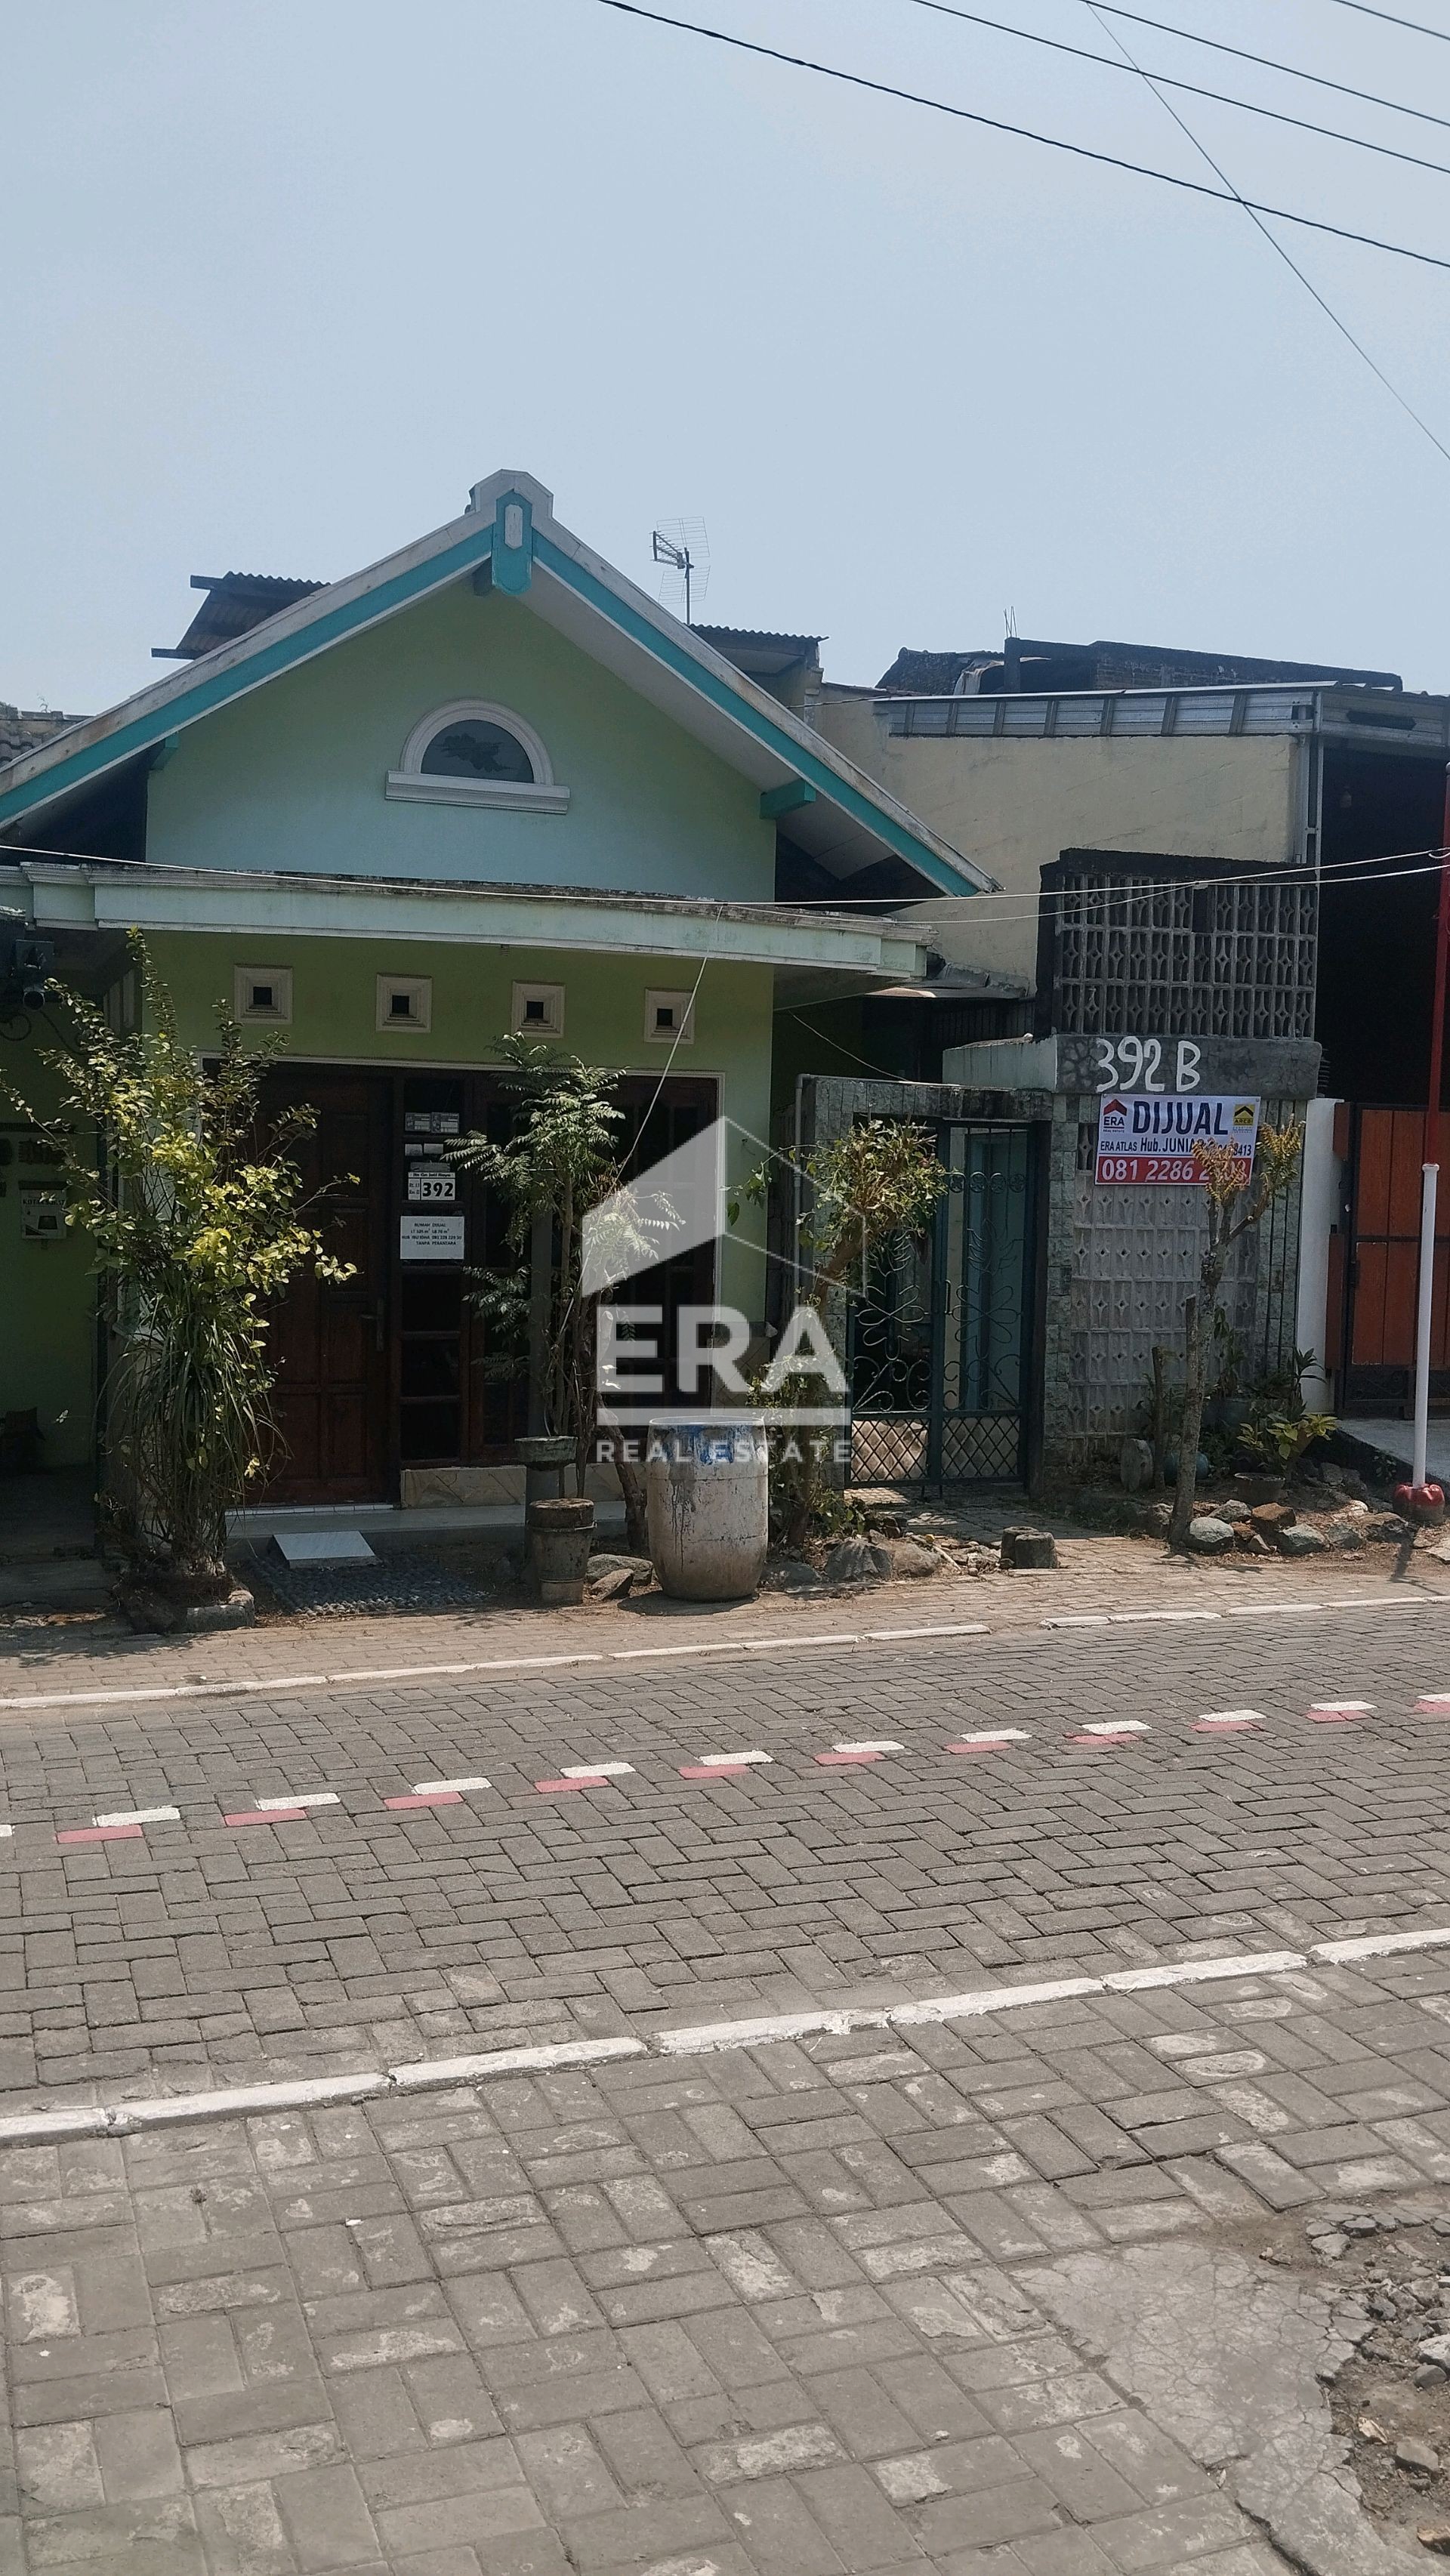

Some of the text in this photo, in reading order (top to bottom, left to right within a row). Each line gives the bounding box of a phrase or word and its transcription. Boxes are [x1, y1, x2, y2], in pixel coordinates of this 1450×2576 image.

[1096, 1035, 1201, 1093] 392 B
[1103, 1116, 1125, 1126] ERA
[1133, 1100, 1228, 1135] DIJUAL
[1100, 1140, 1116, 1151] ERA
[1116, 1141, 1137, 1152] ATLAS
[1102, 1158, 1138, 1180] 081
[1145, 1159, 1194, 1181] 2286
[422, 1182, 453, 1197] 392
